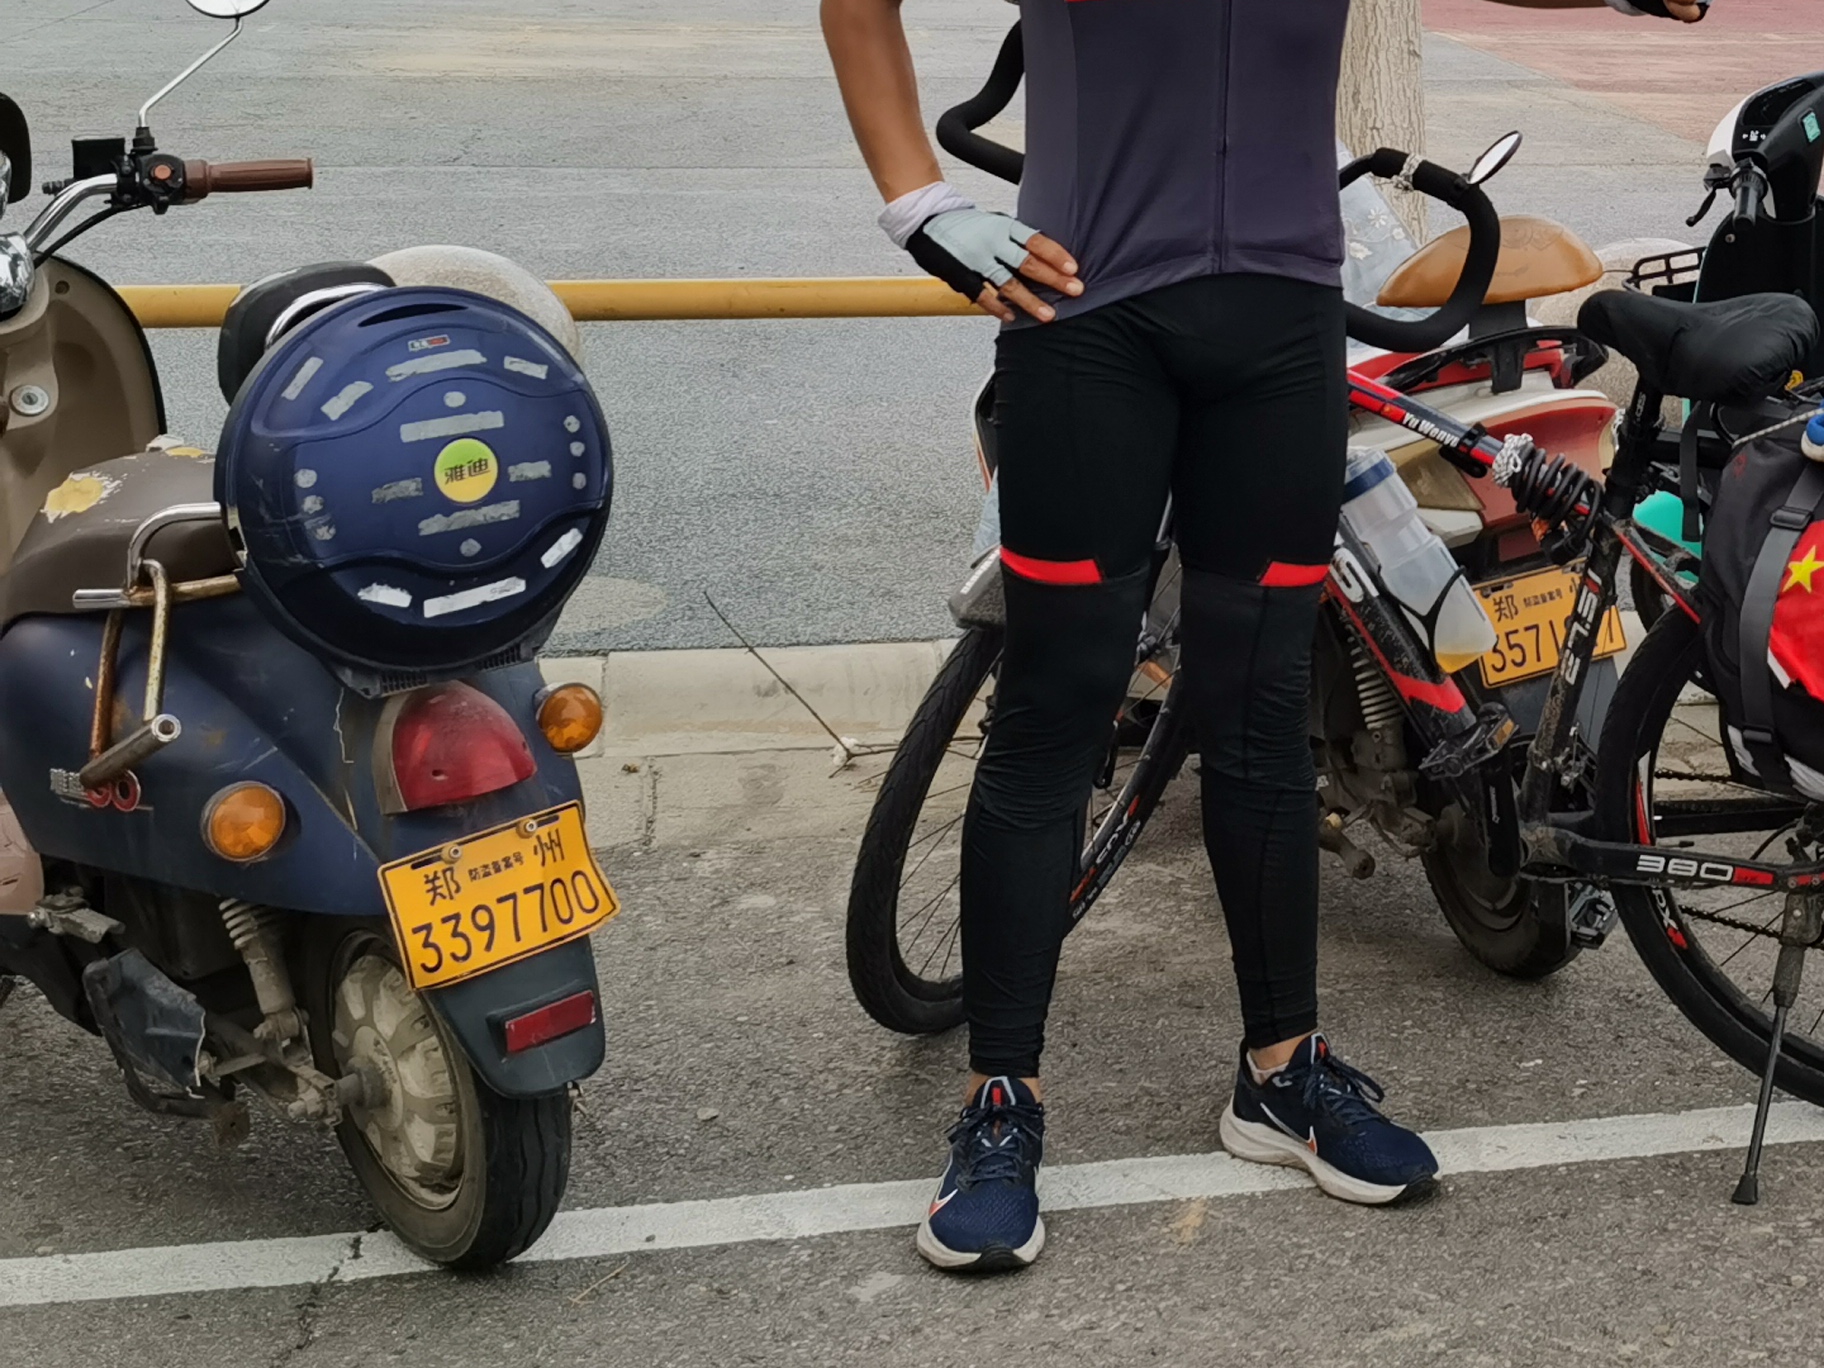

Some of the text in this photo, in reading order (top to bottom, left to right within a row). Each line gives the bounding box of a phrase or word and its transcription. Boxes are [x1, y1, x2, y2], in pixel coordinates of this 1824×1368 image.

[442, 457, 493, 486] 雅迪
[1493, 594, 1519, 622] 郑
[423, 828, 565, 906] 郑 防盗备案号 州
[1636, 854, 1734, 882] 380
[411, 870, 600, 973] 3397700
